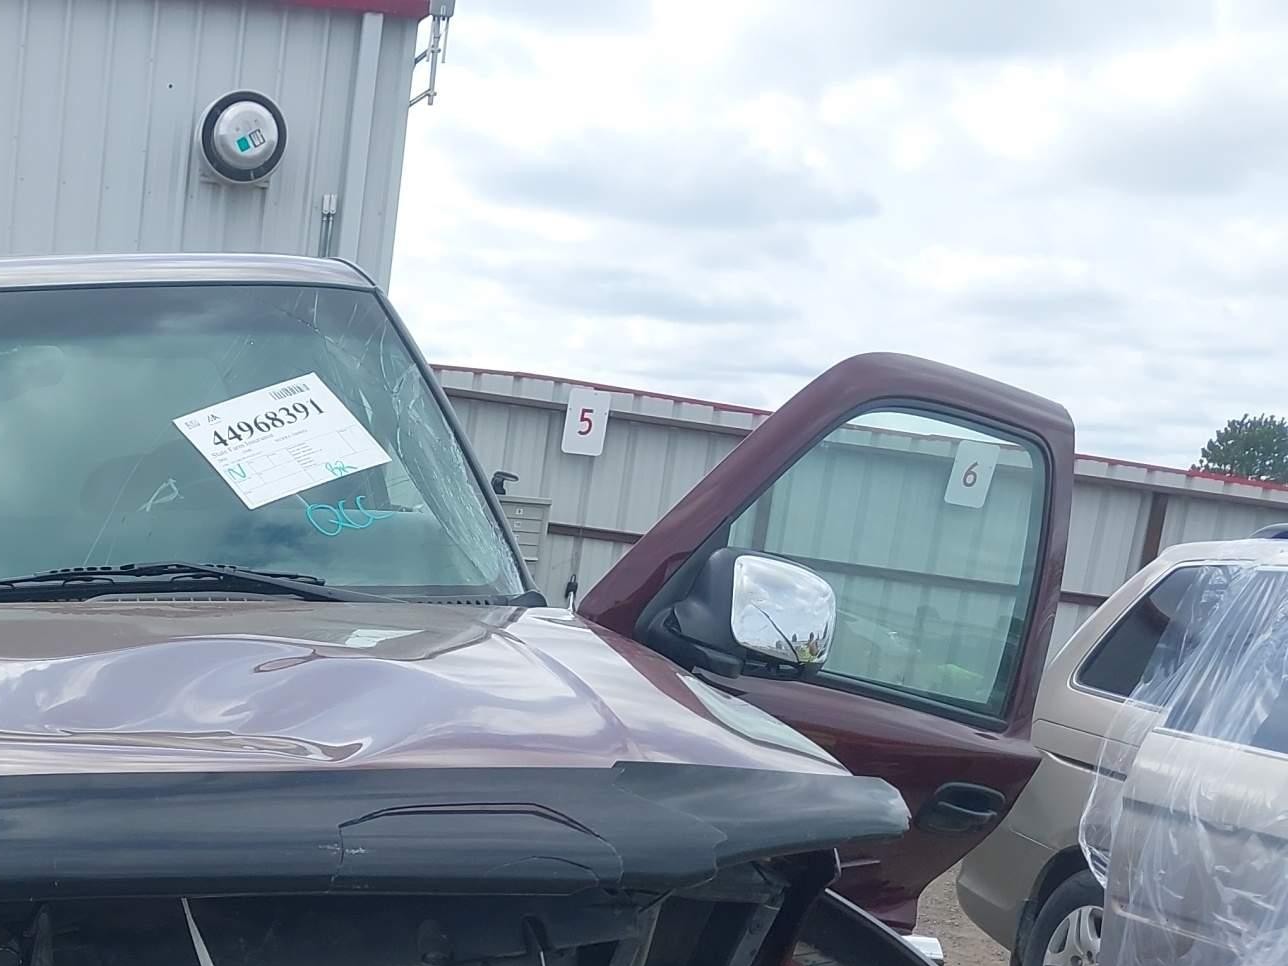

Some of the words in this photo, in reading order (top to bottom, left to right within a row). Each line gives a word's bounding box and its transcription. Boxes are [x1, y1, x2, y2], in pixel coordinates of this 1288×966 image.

[212, 397, 325, 446] 44968391
[576, 407, 594, 436] 5
[962, 462, 979, 488] 6
